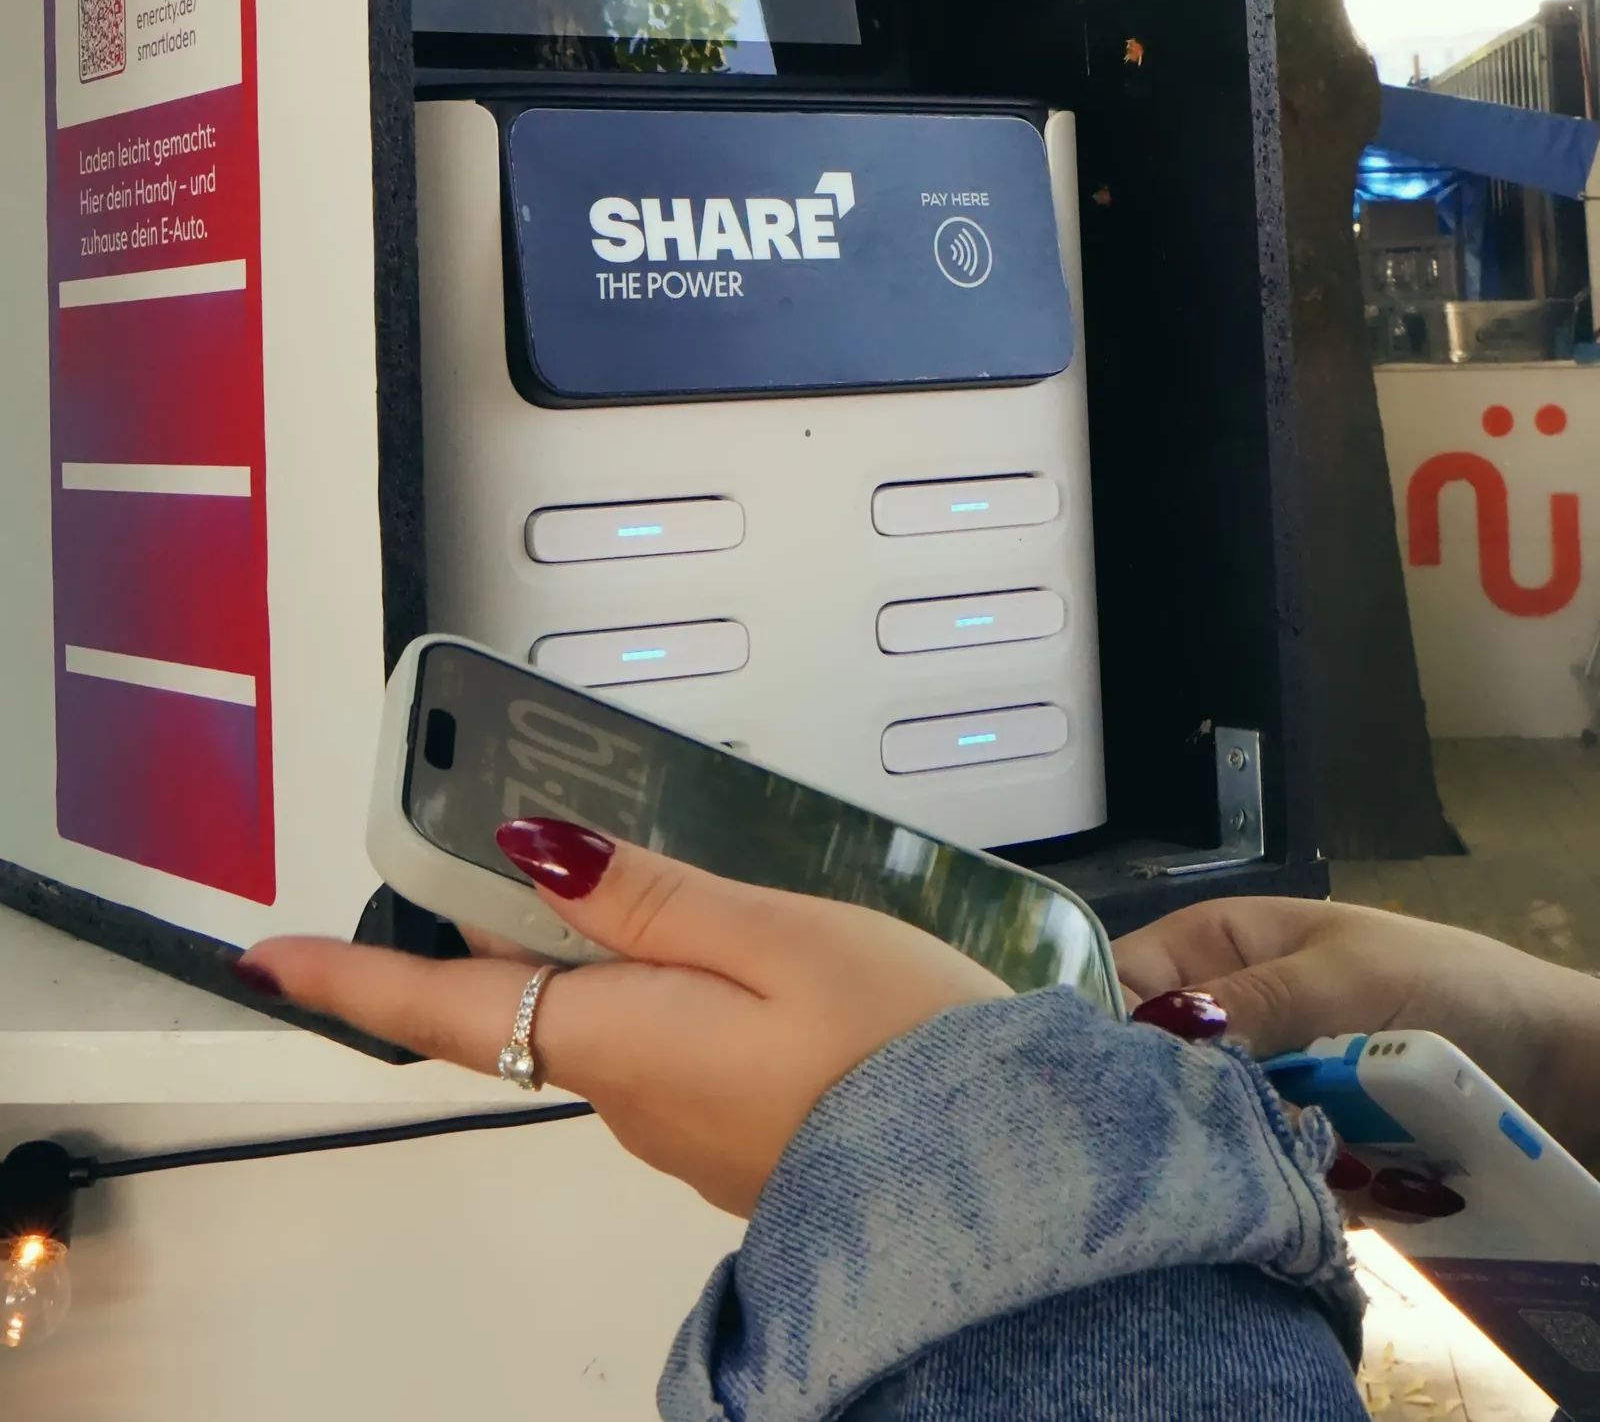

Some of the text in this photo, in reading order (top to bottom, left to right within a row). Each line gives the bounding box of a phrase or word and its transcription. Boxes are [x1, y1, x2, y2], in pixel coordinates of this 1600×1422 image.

[137, 28, 196, 61] smartladen
[79, 123, 216, 175] Laden leicht gemacht:
[80, 187, 104, 215] Hier
[106, 181, 132, 211] dein
[135, 174, 177, 206] Handy
[190, 164, 216, 196] und
[920, 192, 990, 207] PAY HERE
[80, 215, 208, 256] zuhause dein E-Auto.
[588, 196, 840, 263] SHARE
[595, 270, 744, 300] THE POWER
